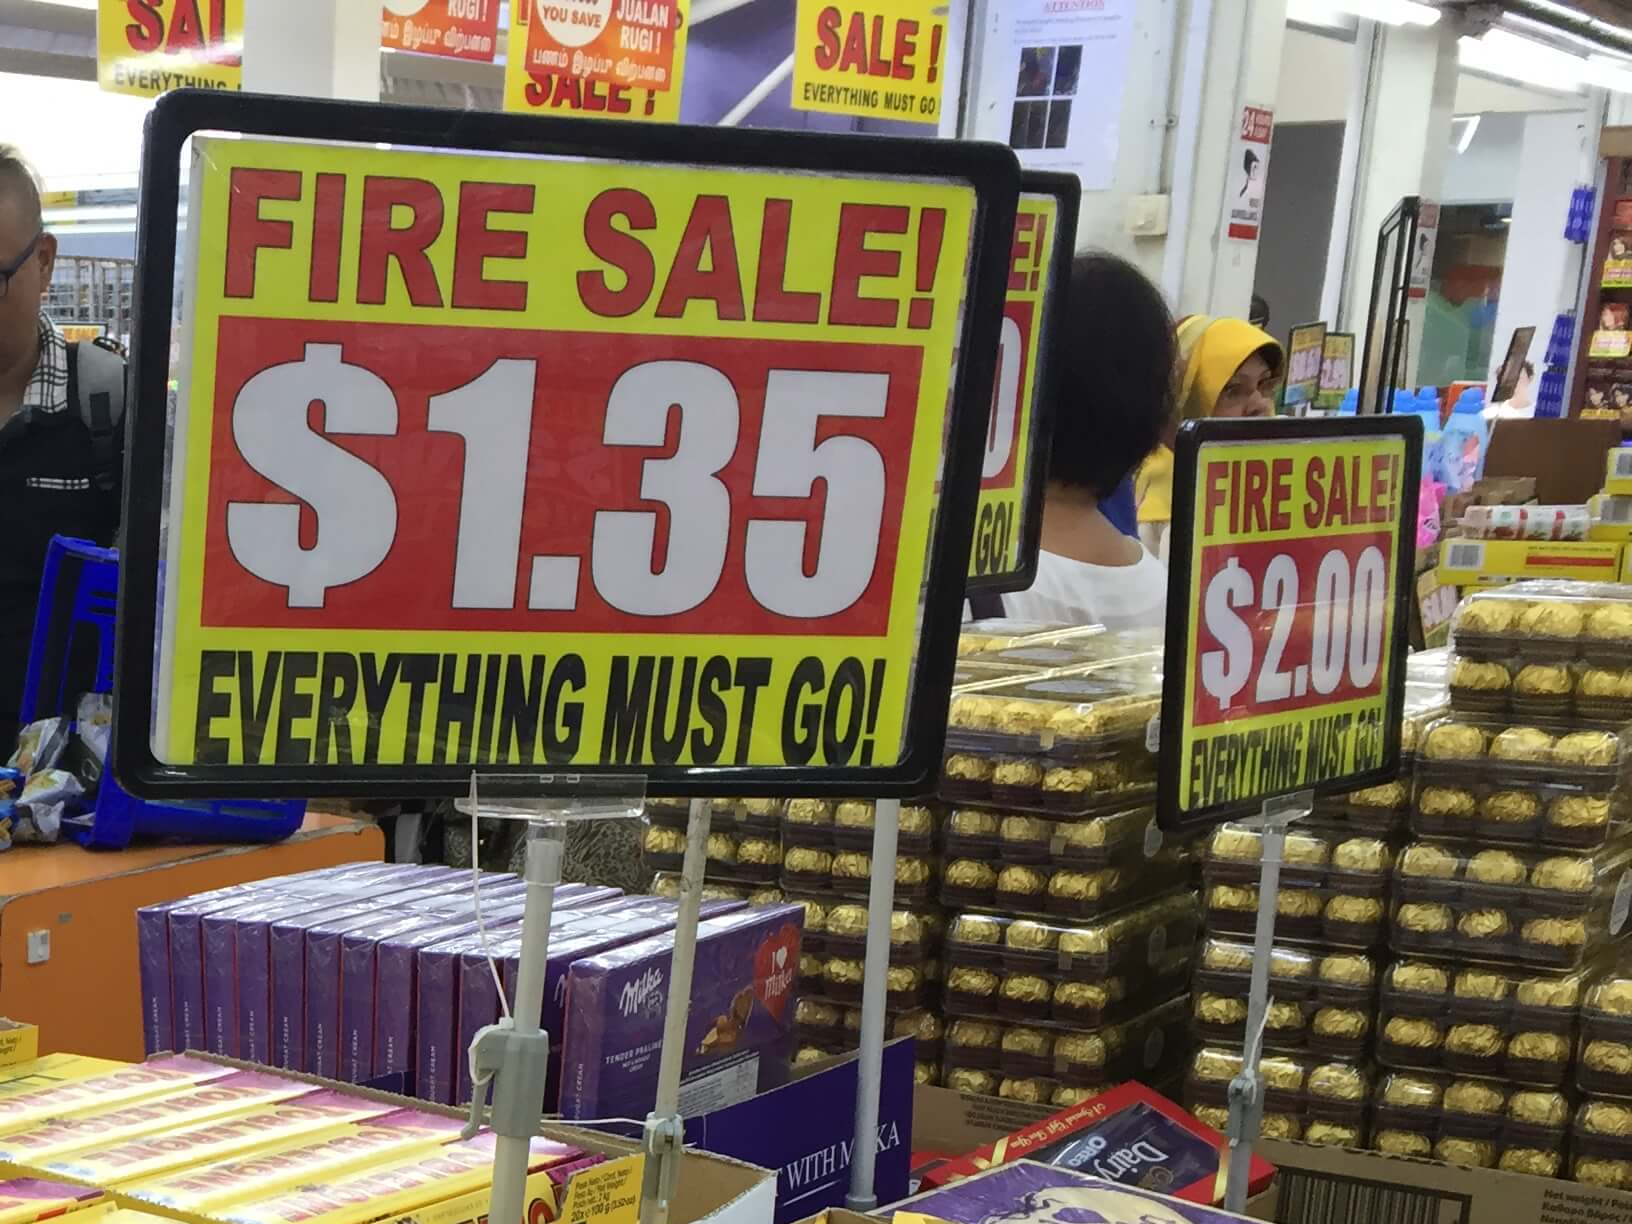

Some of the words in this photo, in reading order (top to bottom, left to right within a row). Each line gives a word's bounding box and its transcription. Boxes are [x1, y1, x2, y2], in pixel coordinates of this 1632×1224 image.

[542, 5, 569, 24] YOU
[571, 11, 603, 29] SAVE
[617, 0, 670, 28] JUALAN
[620, 25, 654, 53] RUGI
[814, 6, 919, 80] SALE
[804, 82, 879, 108] EVERYTHING
[884, 92, 915, 113] MUST
[224, 166, 536, 312] FIRE
[576, 188, 946, 330] SALE!
[225, 343, 891, 620] $1.35
[1203, 457, 1294, 537] FIRE
[1304, 453, 1401, 529] SALE!
[975, 501, 1016, 576] GO!
[1200, 546, 1387, 709] $2.00
[192, 650, 584, 766] EVERYTHING
[599, 656, 772, 767] MUST
[779, 657, 887, 768] GO!
[1189, 716, 1305, 809] EVERYTHING
[1307, 712, 1352, 787] MUST
[1353, 707, 1386, 777] GO!
[619, 967, 665, 1017] Milka
[604, 1049, 635, 1065] TENDER
[786, 1145, 837, 1187] WITH
[1067, 1134, 1108, 1168] OREO
[1093, 1141, 1170, 1184] Dairy
